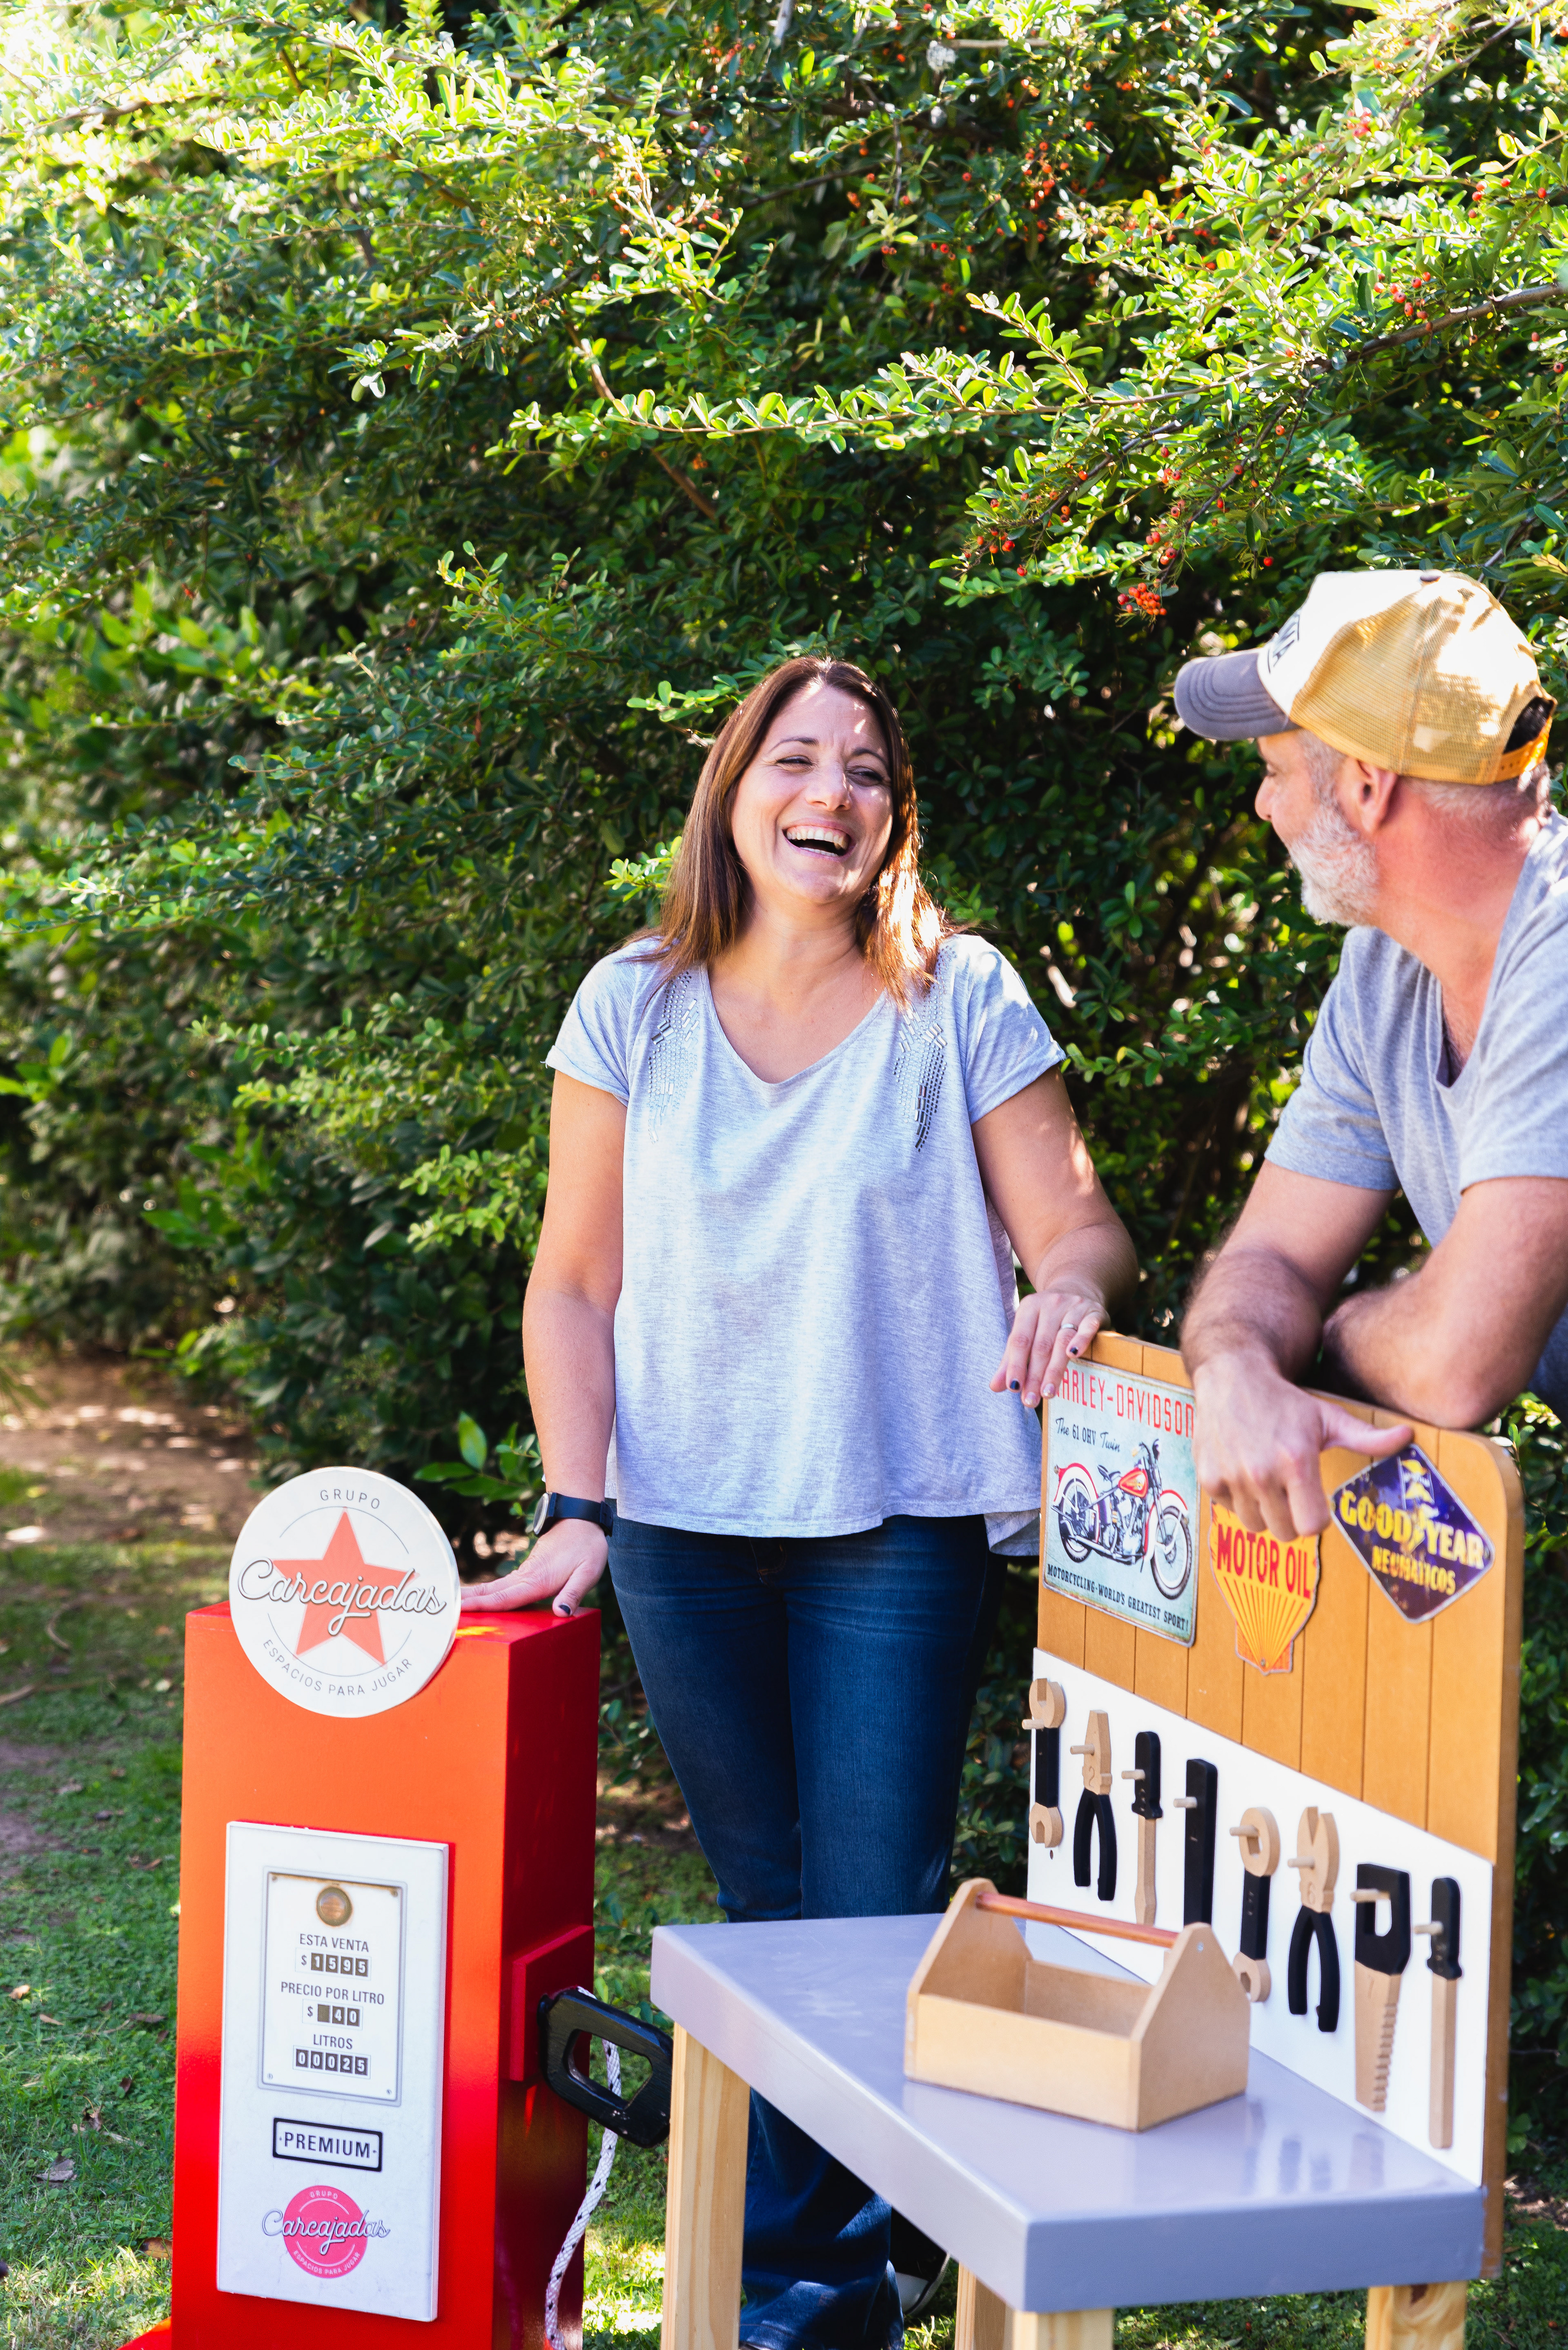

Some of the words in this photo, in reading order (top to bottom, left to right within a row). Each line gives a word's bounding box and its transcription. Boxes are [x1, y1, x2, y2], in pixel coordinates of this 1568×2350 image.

[1056, 1367, 1194, 1439] ARLEY-DAVIDSON
[1056, 1418, 1069, 1435] The
[1072, 1424, 1079, 1440] 61
[1082, 1427, 1096, 1446] OHV
[1100, 1431, 1120, 1453] Twin
[320, 1489, 381, 1509] GRUPO
[1217, 1523, 1279, 1588] MOTOR
[1285, 1545, 1311, 1599] OIL
[238, 1557, 447, 1636] Carcajadas
[1128, 1596, 1161, 1620] GREATEST
[1163, 1611, 1189, 1632] SPORT!
[263, 1639, 322, 1691] ESPACIOS
[328, 1684, 365, 1696] PARA
[372, 1658, 412, 1692] JUGAR
[299, 1933, 328, 1947] ESTA
[332, 1937, 369, 1952] VENTA
[301, 1955, 307, 1966] $
[281, 1981, 322, 1997] PRECIO
[326, 1987, 349, 2000] POR
[352, 1990, 385, 2005] LITRO
[307, 2006, 314, 2017] $
[334, 2007, 358, 2025] 40
[313, 2034, 353, 2050] LITROS
[284, 2131, 370, 2159] PREMIUM
[310, 2190, 338, 2200] GRUPO
[262, 2208, 390, 2256] Carcajadas
[293, 2250, 323, 2274] ESPACIOS
[343, 2252, 361, 2271] JUGAR
